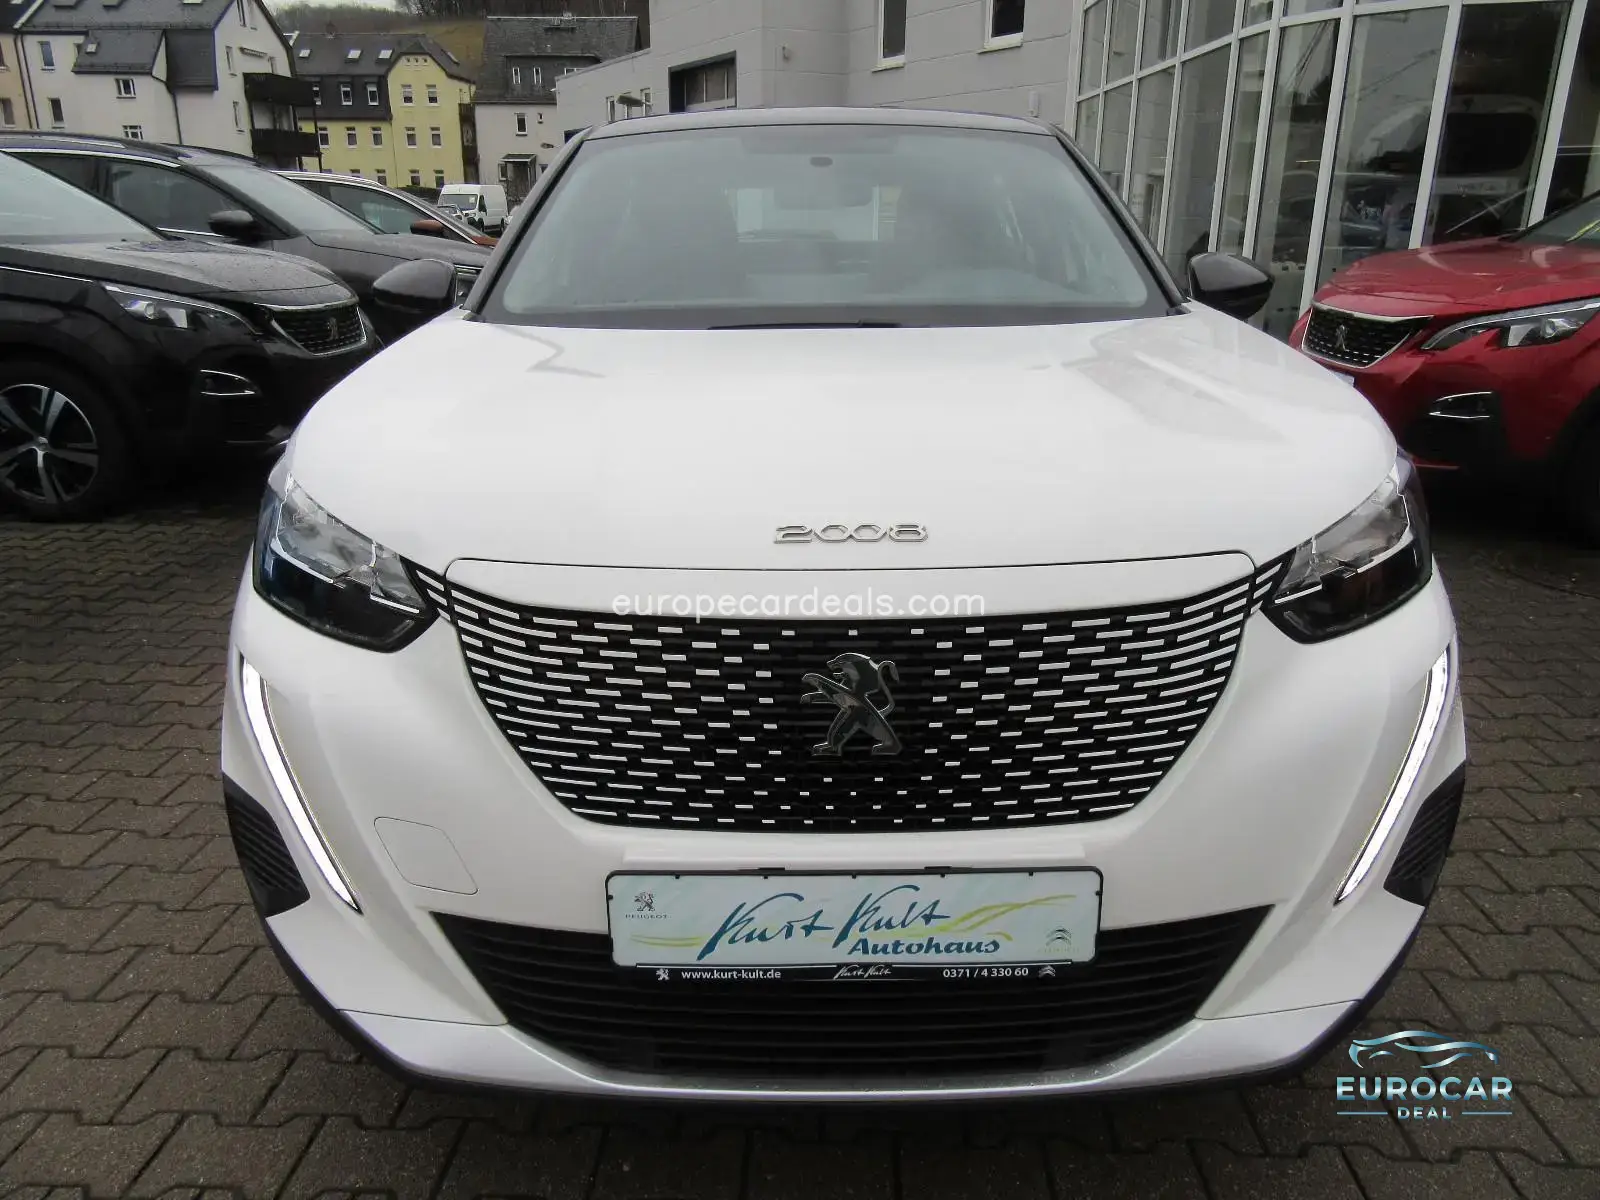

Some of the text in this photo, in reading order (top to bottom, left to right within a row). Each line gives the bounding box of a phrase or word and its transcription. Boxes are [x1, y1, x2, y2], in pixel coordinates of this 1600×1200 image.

[774, 523, 928, 544] 2008
[696, 884, 951, 961] Kurt Kult
[847, 936, 1000, 955] Autohaus
[681, 969, 781, 979] www.kurt-kult.de
[942, 968, 970, 978] 0371
[981, 968, 988, 977] 4
[990, 967, 1012, 977] 330
[1014, 967, 1029, 976] 60
